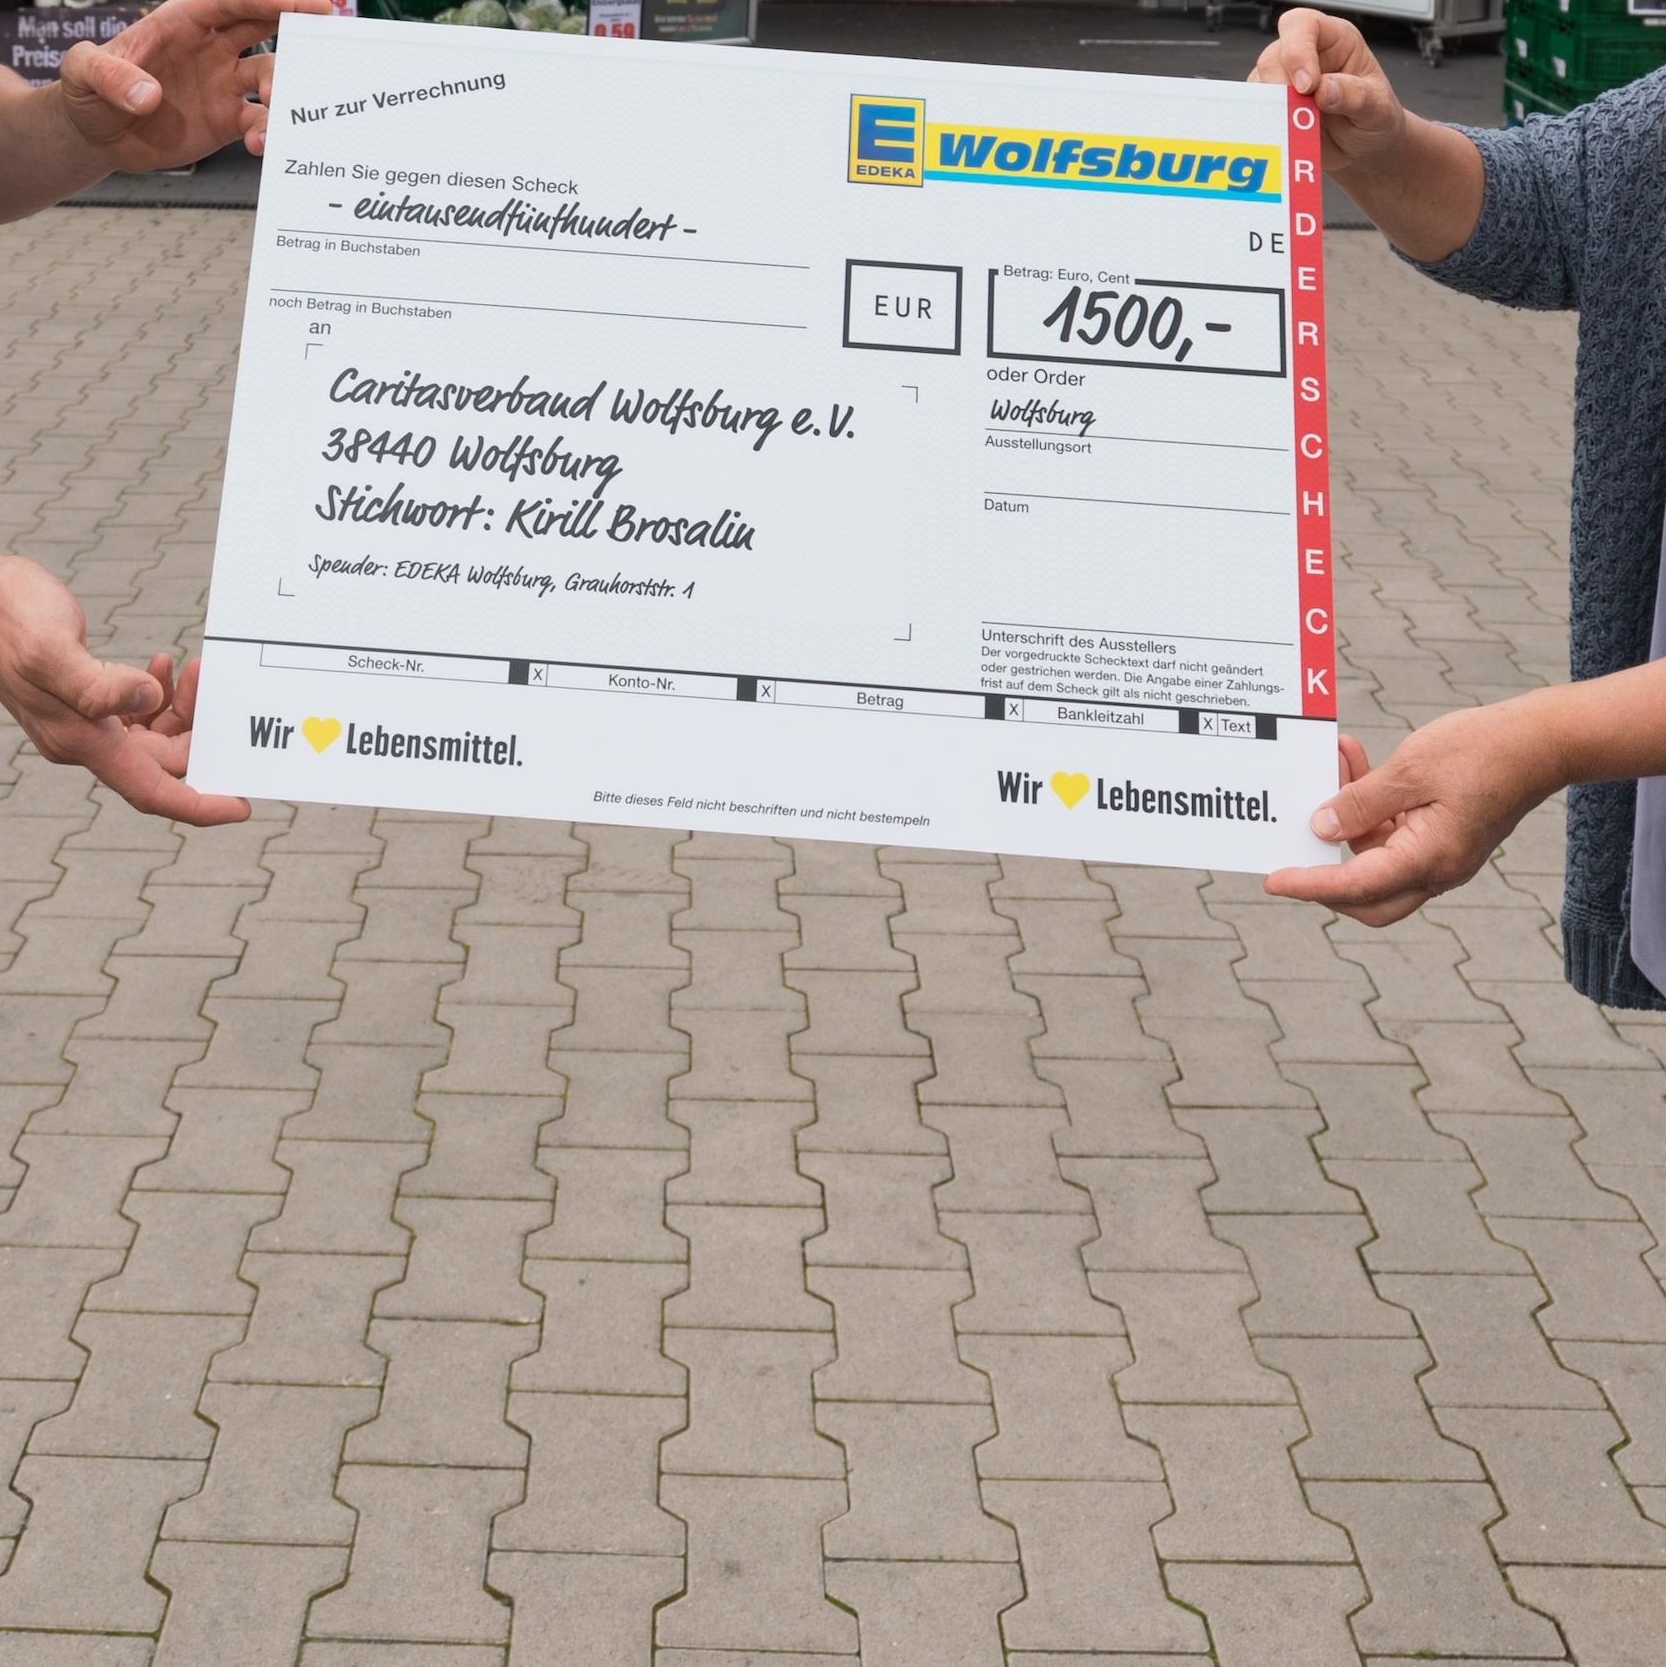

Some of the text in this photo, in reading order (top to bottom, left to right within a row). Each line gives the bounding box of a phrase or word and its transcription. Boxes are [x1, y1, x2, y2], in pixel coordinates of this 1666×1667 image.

[18, 16, 128, 38] Man soll die
[290, 73, 506, 125] Nur zur Verrechnung
[856, 166, 916, 180] EDEKA
[939, 132, 1269, 194] Wolfsburg
[284, 159, 579, 195] Zahlen Sie gegen diesen Scheck
[353, 192, 677, 241] eintausendfünfhundert
[276, 235, 421, 256] Betrag in Buchstaben
[1004, 265, 1131, 285] Betrag: Euro, Cent
[269, 295, 452, 319] noch Betrag in Buchstaben
[874, 294, 934, 320] EUR
[308, 320, 332, 335] an
[1043, 286, 1232, 363] 1500,-
[986, 368, 1087, 387] oder Order
[330, 367, 608, 421] Caritasverband
[610, 388, 783, 451] Wolfsburg
[989, 399, 1096, 437] Wolfsburg
[985, 435, 1092, 455] Ausstellungsort
[322, 427, 623, 499] 38440 Wolfsburg
[315, 482, 755, 550] Stichwort: Kirill Brosalin
[984, 498, 1030, 514] Datum
[309, 554, 388, 578] Spender:
[394, 560, 461, 584] EDEKA
[467, 565, 556, 597] Wolfsburg,
[682, 581, 695, 599] 1
[981, 629, 1177, 655] Unterschrift des Ausstellers
[348, 655, 425, 673] Scheck-Nr.
[981, 646, 1264, 677] Der vorgedruckte Schecktext darf nicht geändert
[532, 668, 544, 681] X
[608, 673, 676, 691] Konto-Nr.
[981, 662, 1285, 695] oder gestrichen werden. Die Angabe einer Zahlungs-
[761, 684, 772, 698] X
[857, 692, 904, 710] Betrag
[981, 678, 1251, 707] frist auf dem Scheck gilt als nicht geschrieben.
[1009, 703, 1019, 716] X
[1058, 706, 1145, 726] Bankleitzahl
[1203, 718, 1213, 731] X
[1221, 719, 1252, 733] Text
[249, 715, 523, 767] Wir Lebensmittel.
[997, 770, 1277, 823] Wir Lebensmittel.
[592, 791, 931, 828] Bitte dieses Feld nicht beschriften und nicht bestempeln
